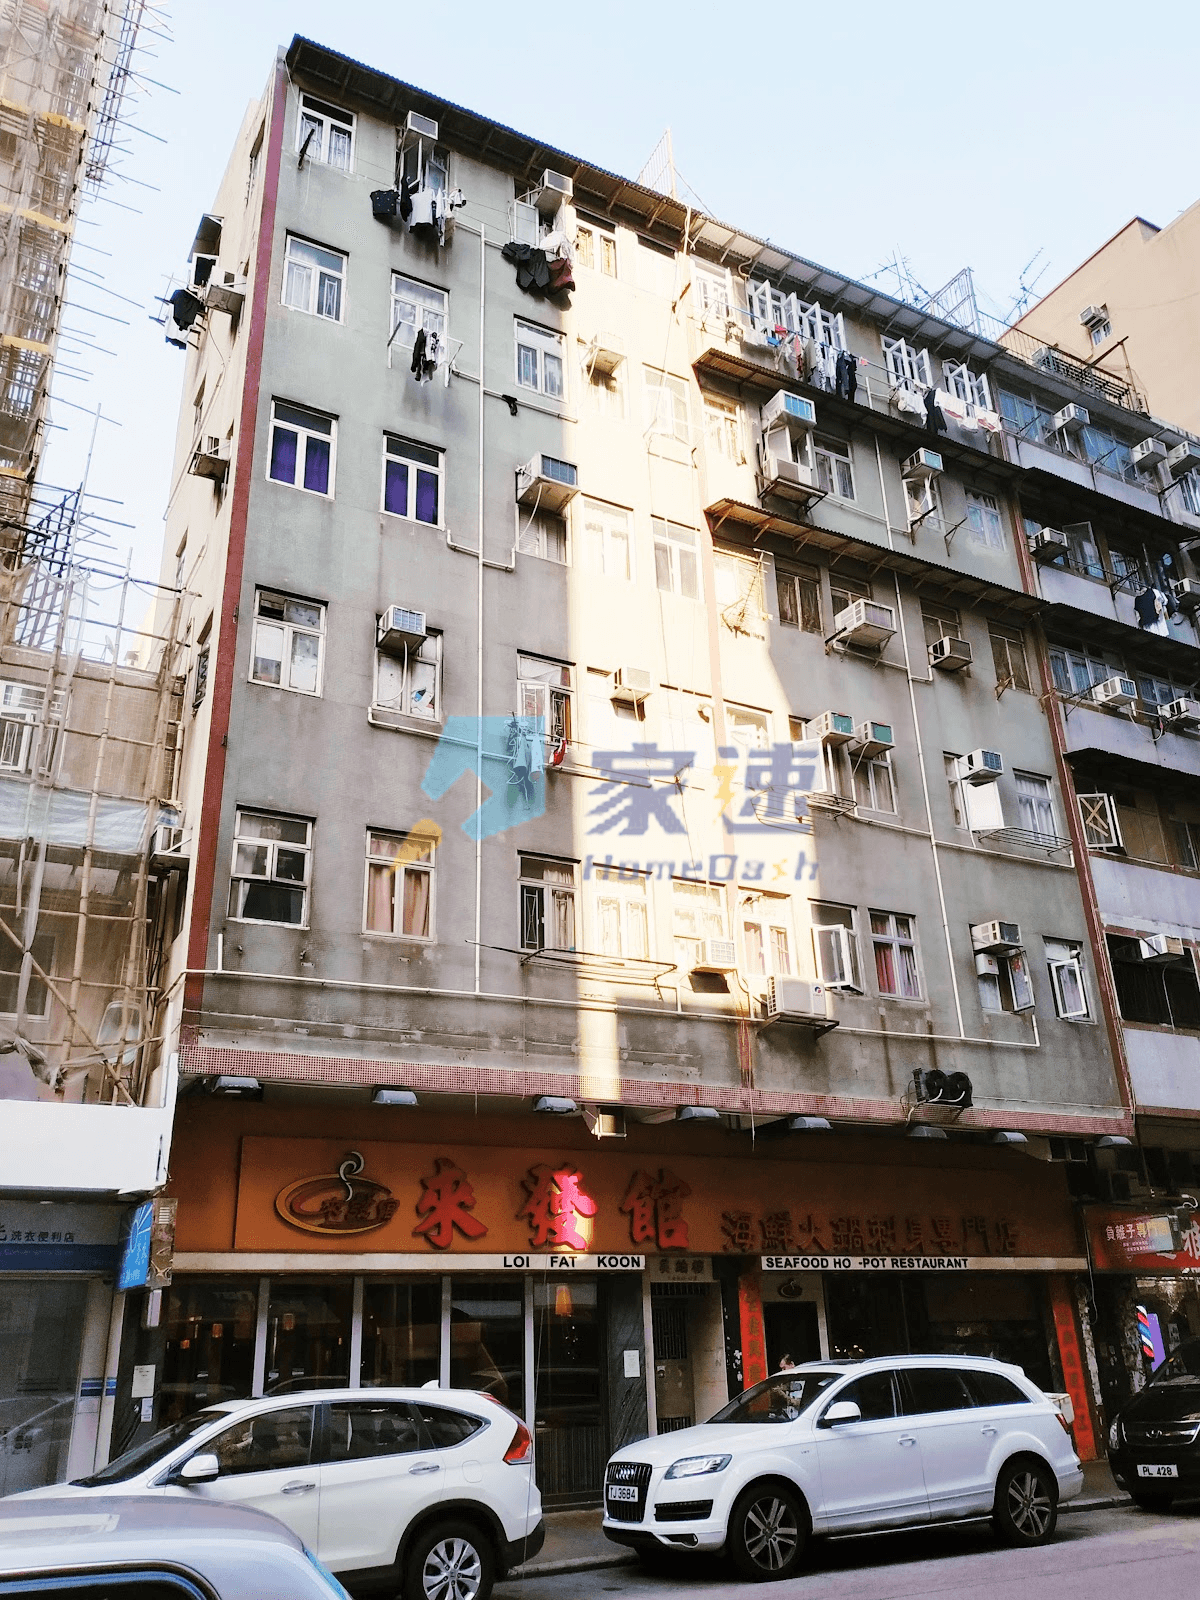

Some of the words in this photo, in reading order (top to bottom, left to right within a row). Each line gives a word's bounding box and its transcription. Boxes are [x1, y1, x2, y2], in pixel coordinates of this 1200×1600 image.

[503, 1256, 530, 1268] LOI
[550, 1256, 578, 1268] FAT
[597, 1256, 641, 1268] KOON
[765, 1257, 829, 1269] SEAFOOD
[891, 1257, 969, 1269] RESTAURANT
[1142, 1466, 1154, 1476] PL
[1156, 1466, 1173, 1476] 428
[610, 1486, 618, 1499] TJ
